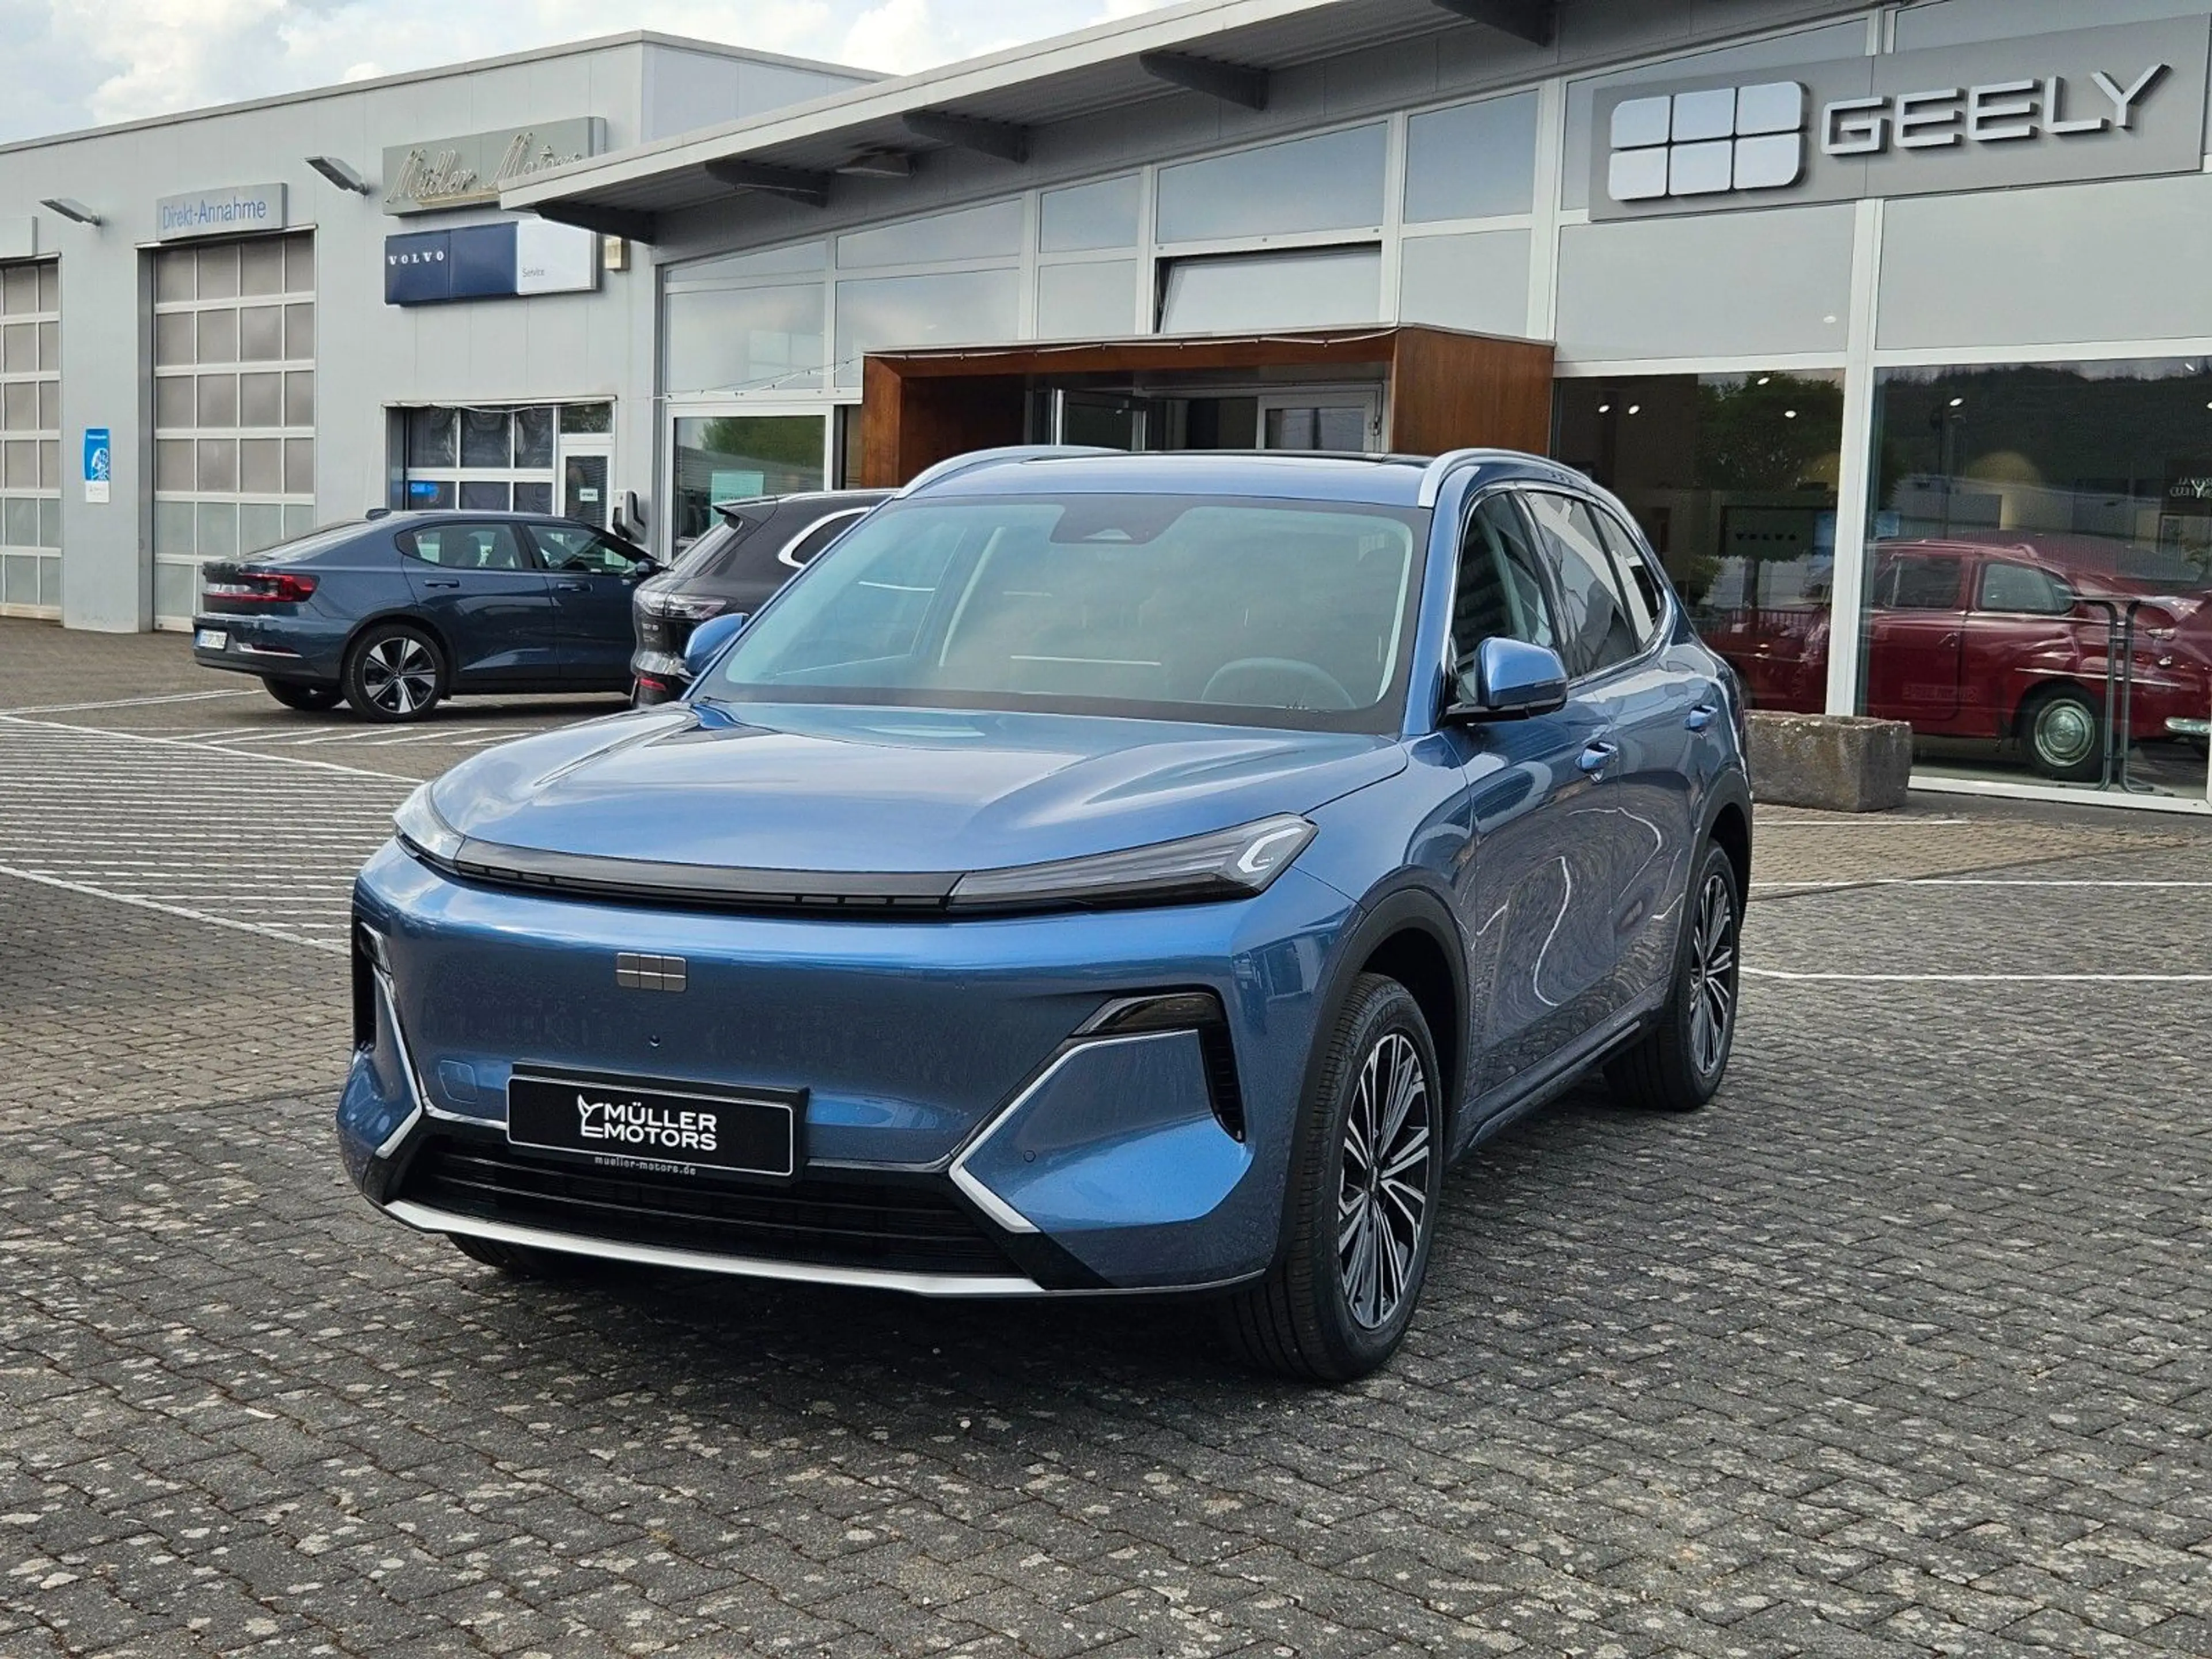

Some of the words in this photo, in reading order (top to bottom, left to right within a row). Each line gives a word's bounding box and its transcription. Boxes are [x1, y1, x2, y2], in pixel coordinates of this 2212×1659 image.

[1821, 63, 2172, 156] GEELY
[162, 196, 267, 229] Direkt-Annahme
[389, 251, 444, 265] VOLVO
[604, 1101, 717, 1132] MÜLLER
[604, 1122, 717, 1151] MOTORS
[594, 1157, 696, 1175] mueller-motors.de
